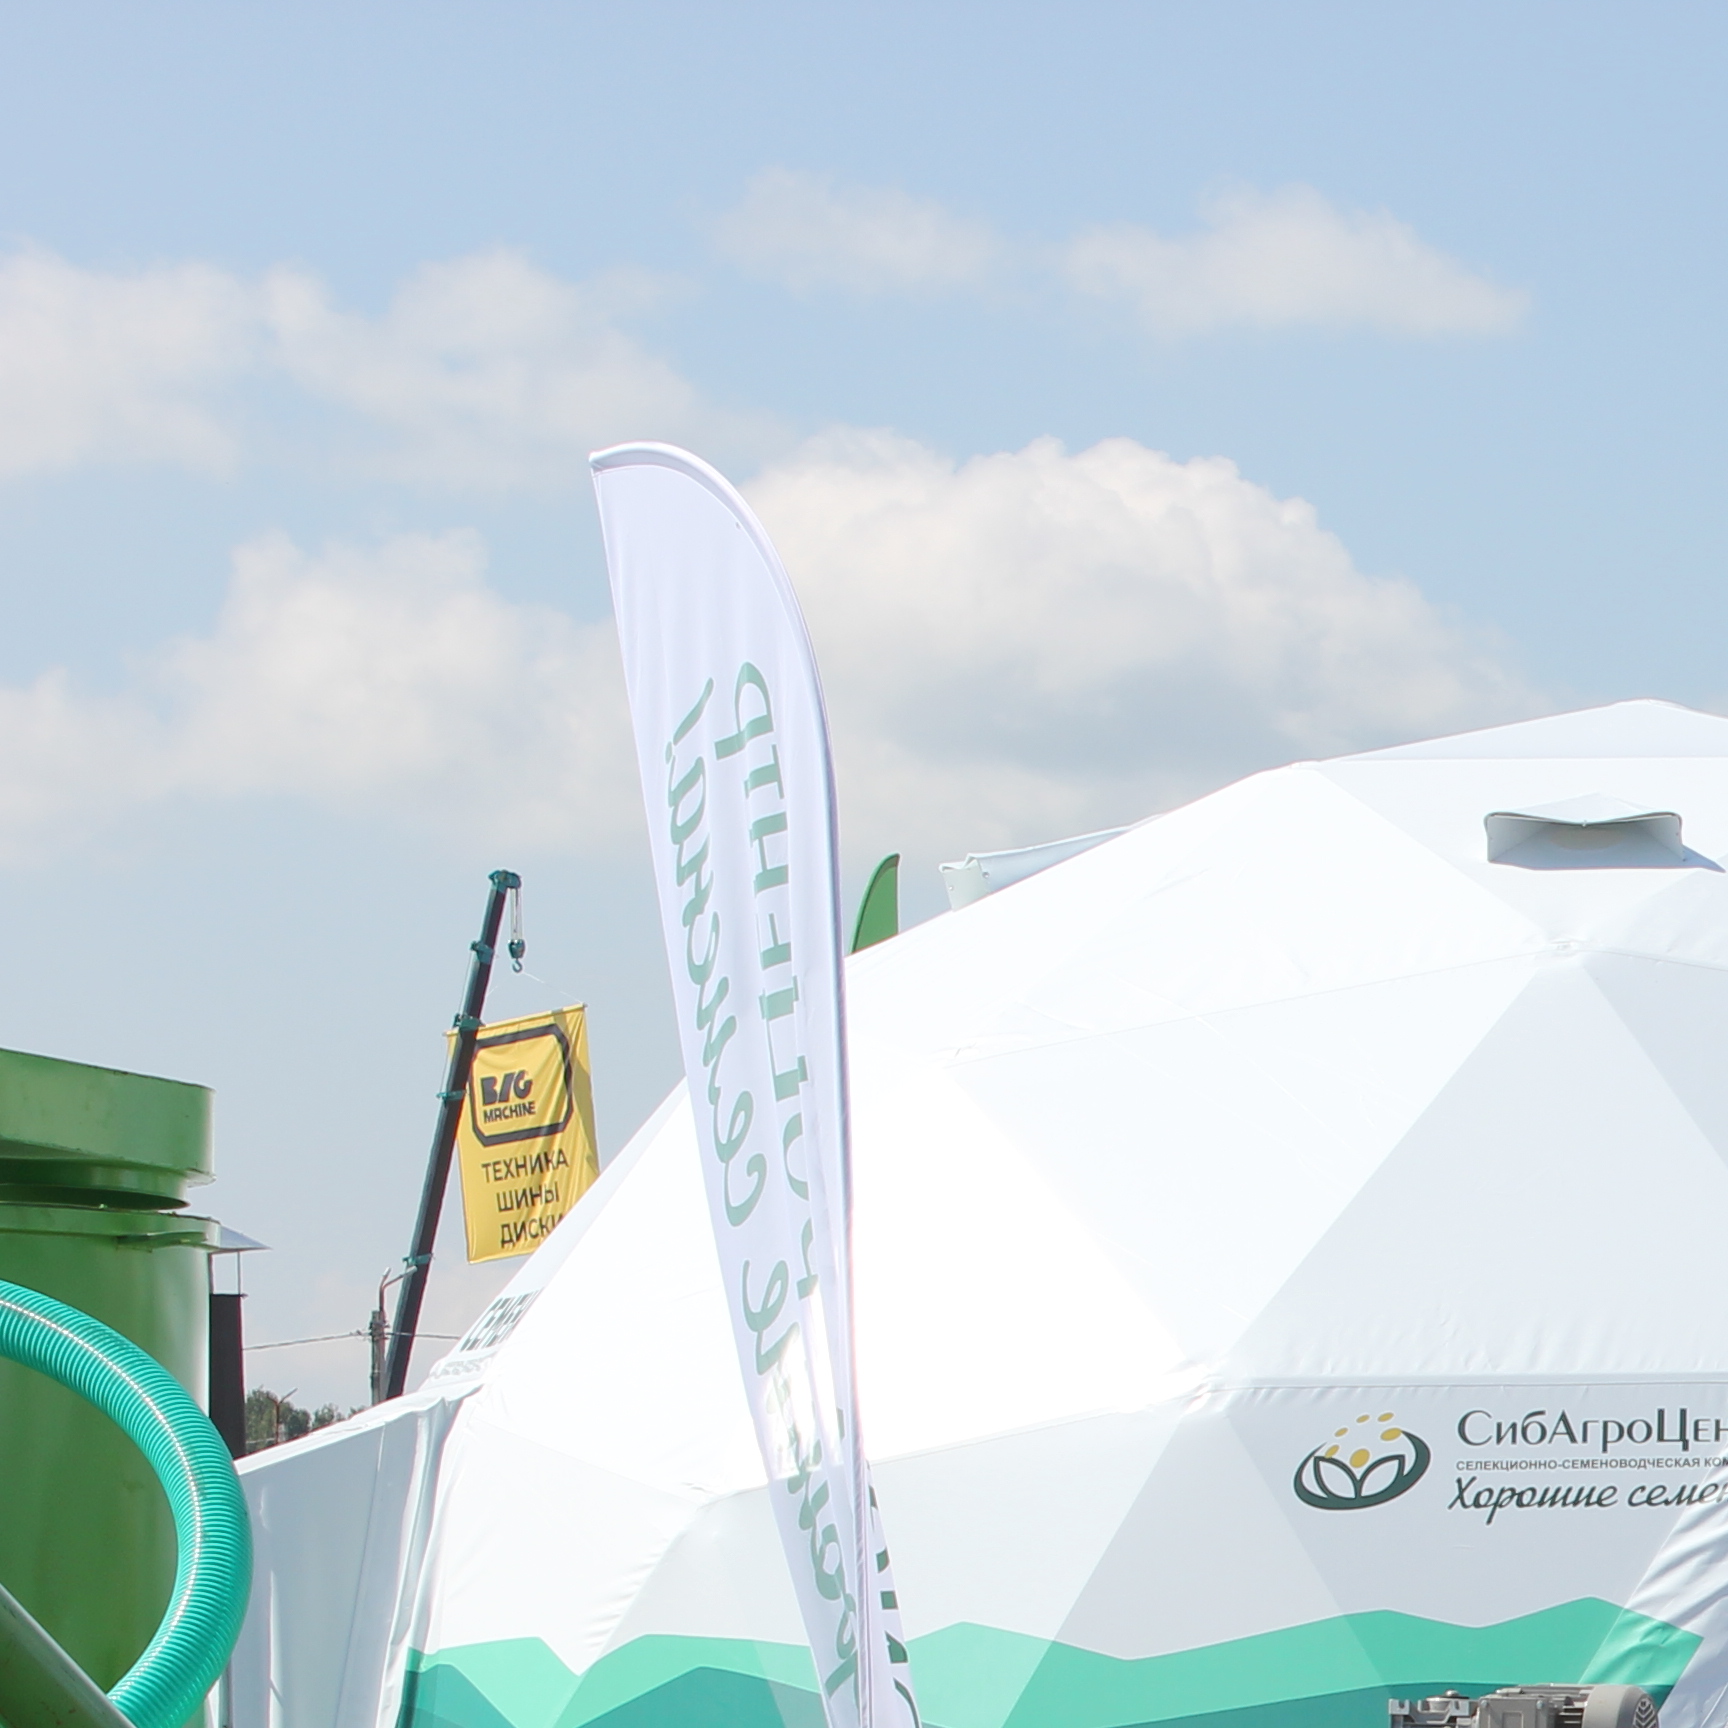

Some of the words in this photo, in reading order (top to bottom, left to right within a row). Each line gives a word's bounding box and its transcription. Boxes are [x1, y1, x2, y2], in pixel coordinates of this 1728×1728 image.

[483, 1101, 536, 1124] MACHINE
[481, 1148, 569, 1184] ТЕХНИКА
[496, 1181, 560, 1212] ШИНЫ
[500, 1213, 564, 1249] ДИСКИ
[1456, 1457, 1700, 1471] СЕЛЕКЦИОННО-СЕМЕНОВОДЧЕСКАЯ
[1447, 1475, 1619, 1526] Хорошие
